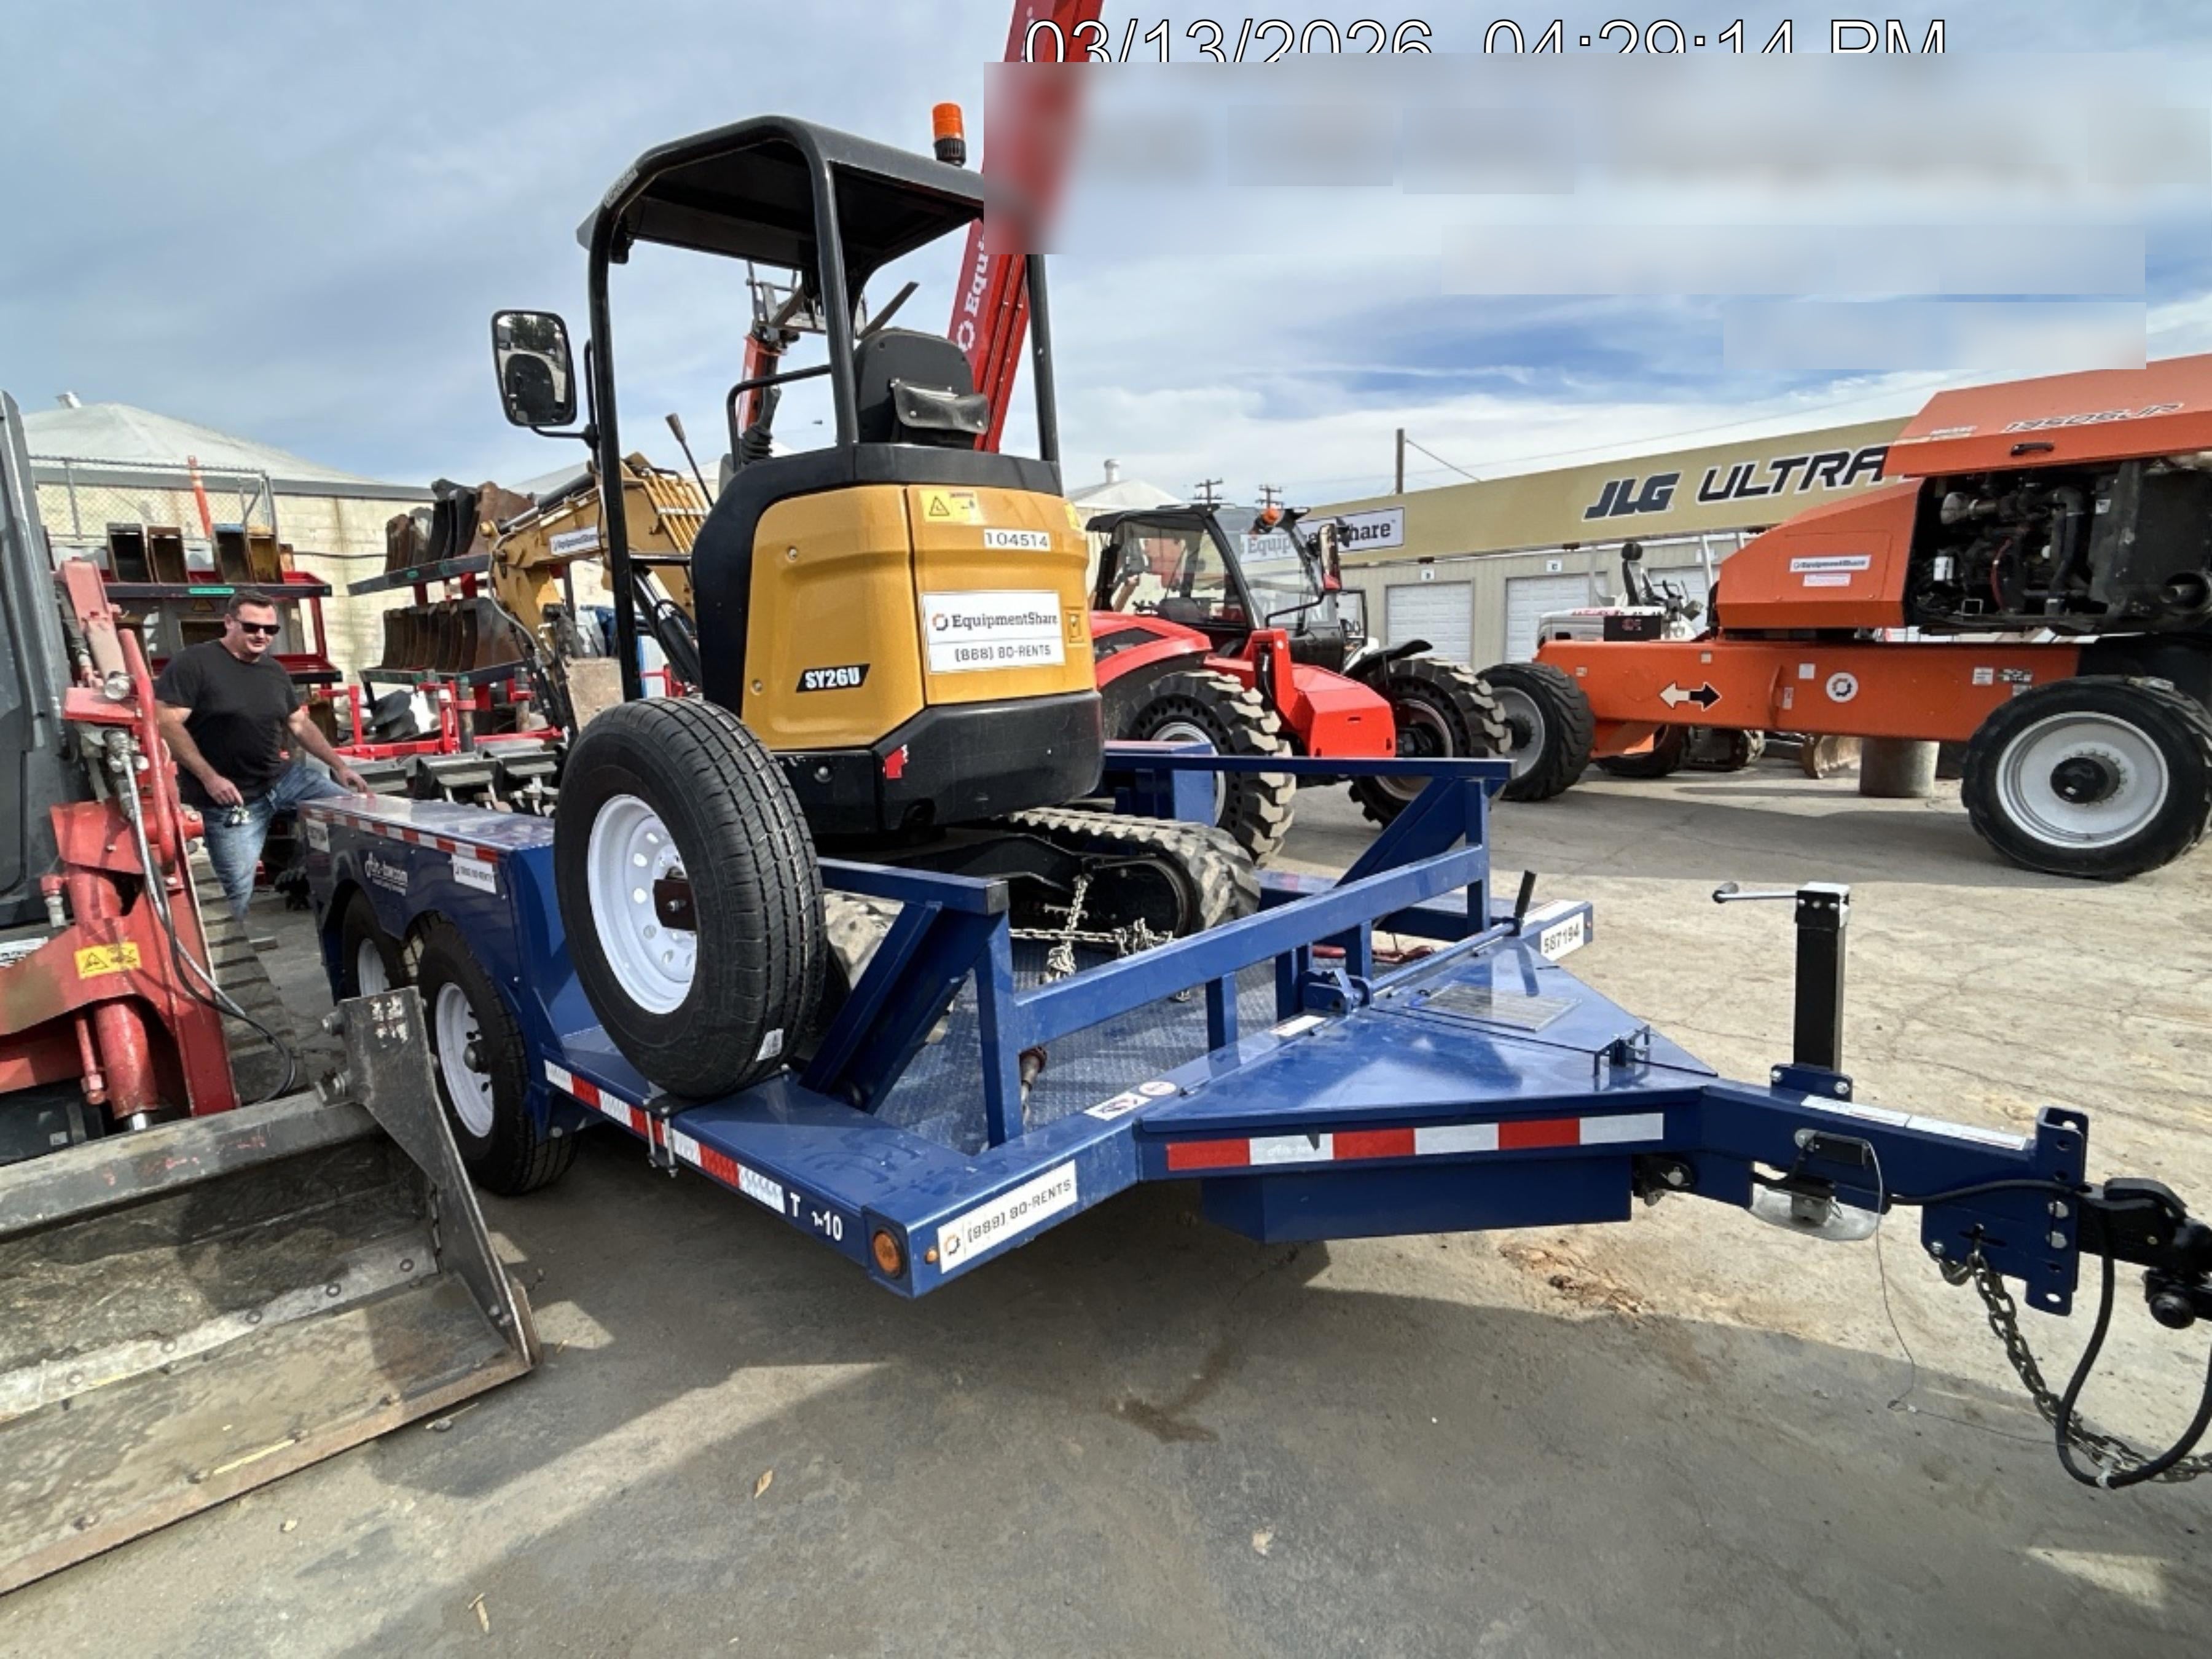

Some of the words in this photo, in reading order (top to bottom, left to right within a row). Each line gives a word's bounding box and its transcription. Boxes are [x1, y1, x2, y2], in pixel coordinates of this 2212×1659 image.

[1583, 472, 1680, 520] JLG
[1696, 445, 1890, 503] ULTRA
[986, 532, 1048, 547] 104514
[951, 611, 1057, 630] EquipmentShare
[805, 667, 860, 689] SY26U
[1010, 1179, 1072, 1219] 80-RENTS
